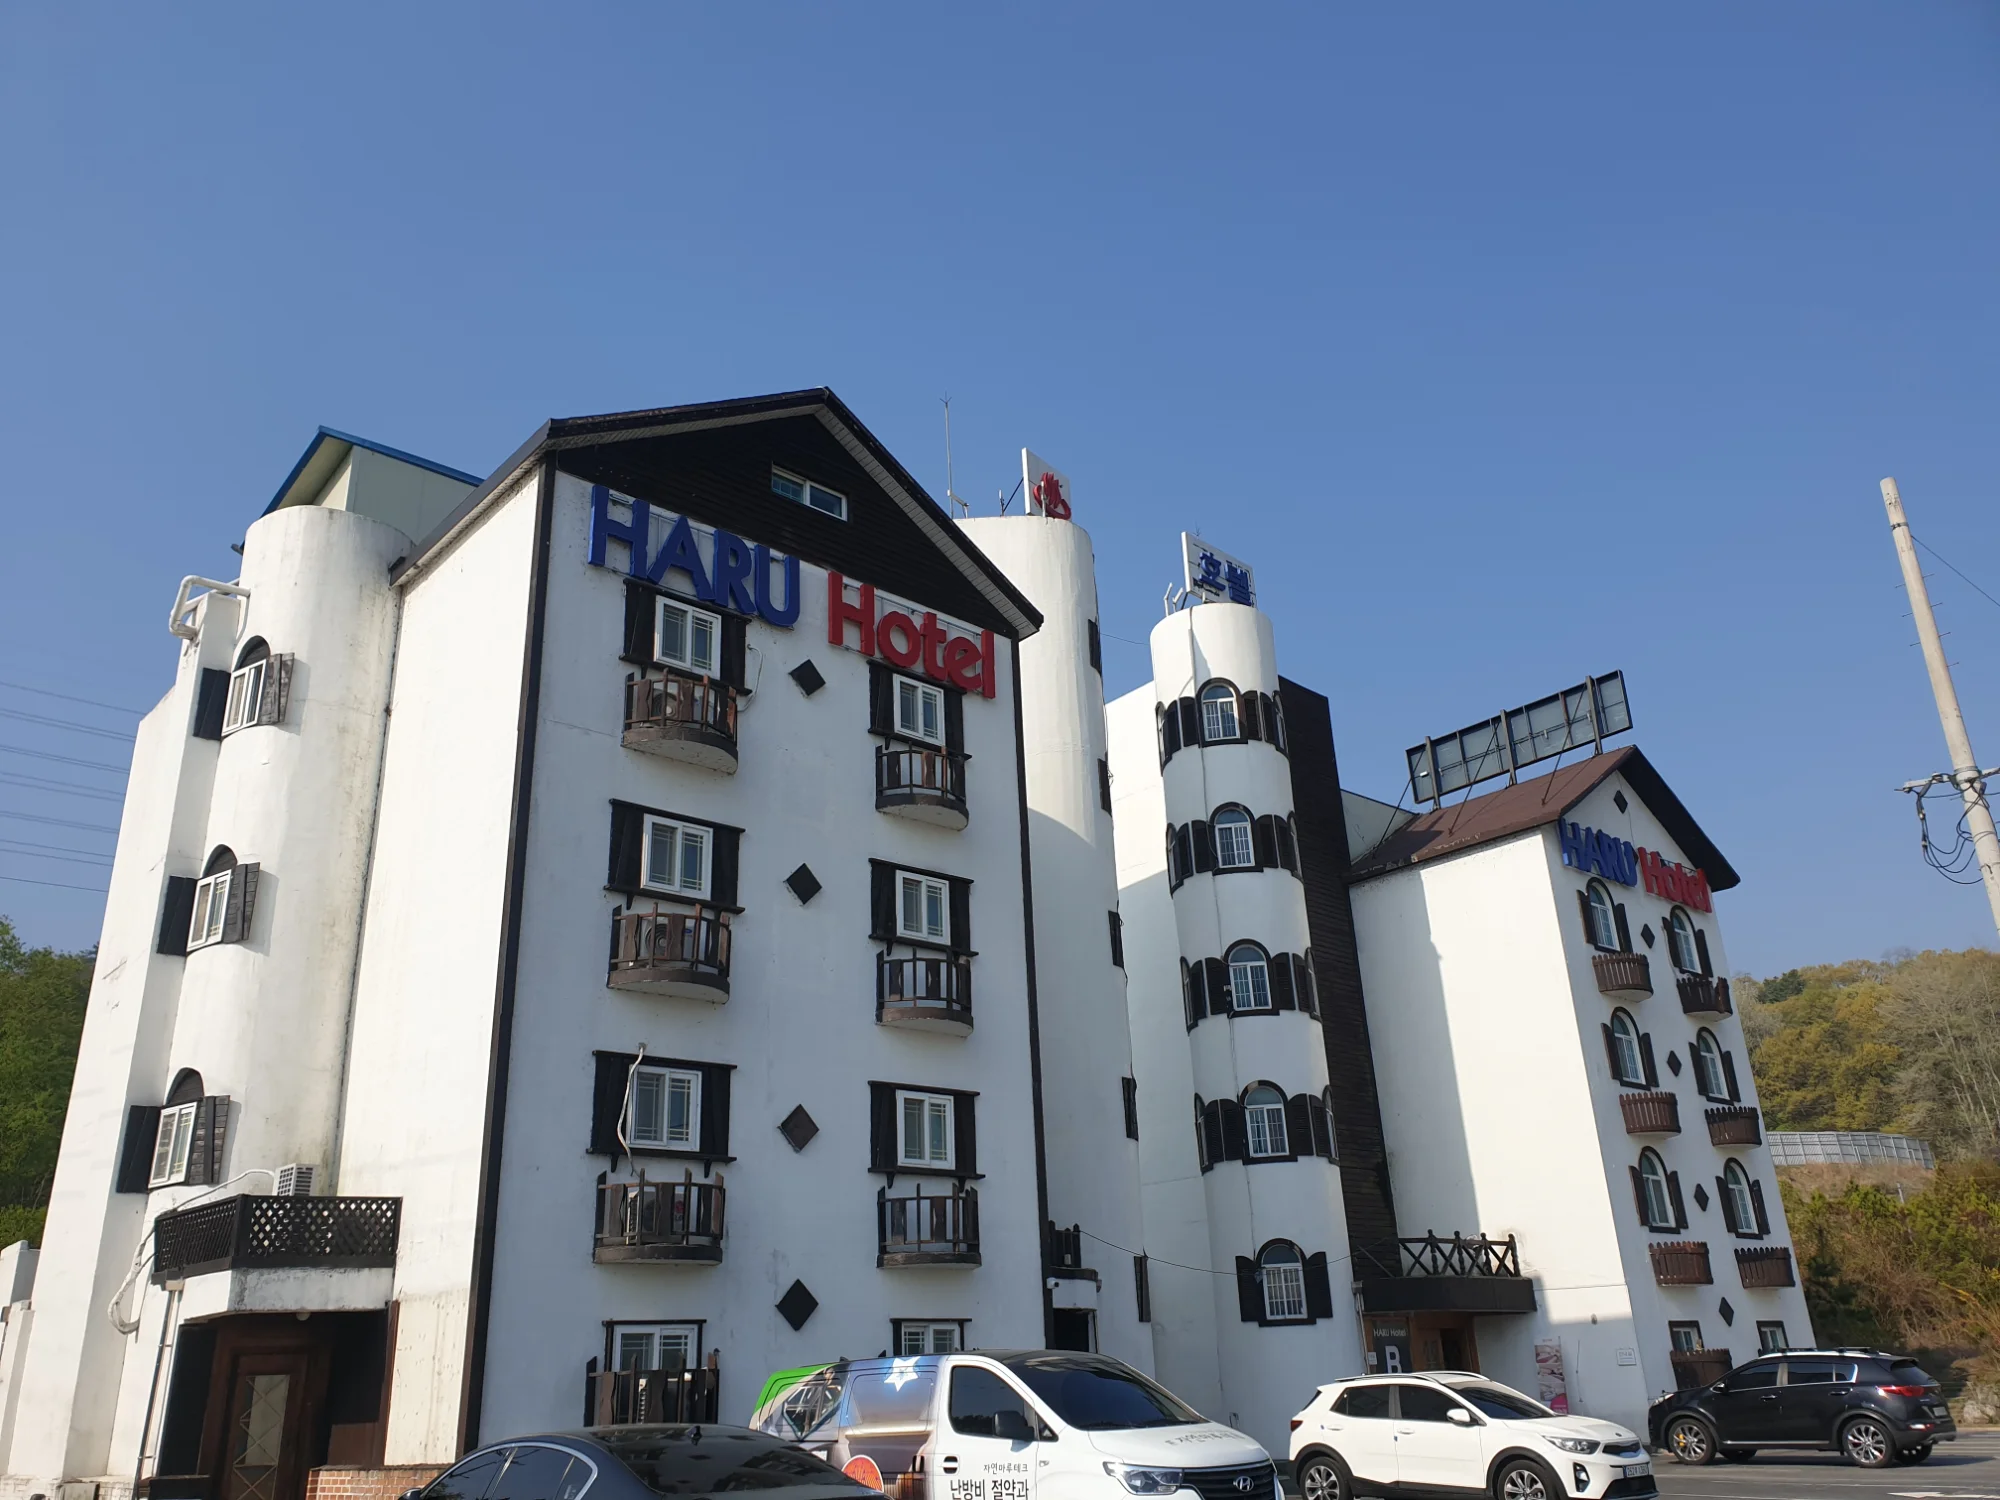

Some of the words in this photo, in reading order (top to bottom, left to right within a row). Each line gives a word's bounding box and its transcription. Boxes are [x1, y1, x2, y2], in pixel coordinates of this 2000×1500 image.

[588, 484, 800, 628] HARU
[827, 570, 996, 700] Hotel
[1198, 552, 1252, 607] 호텔
[1558, 816, 1638, 888] HARU
[1637, 846, 1712, 913] Hotel
[950, 1478, 986, 1500] 난방비
[991, 1478, 1029, 1500] 절약과
